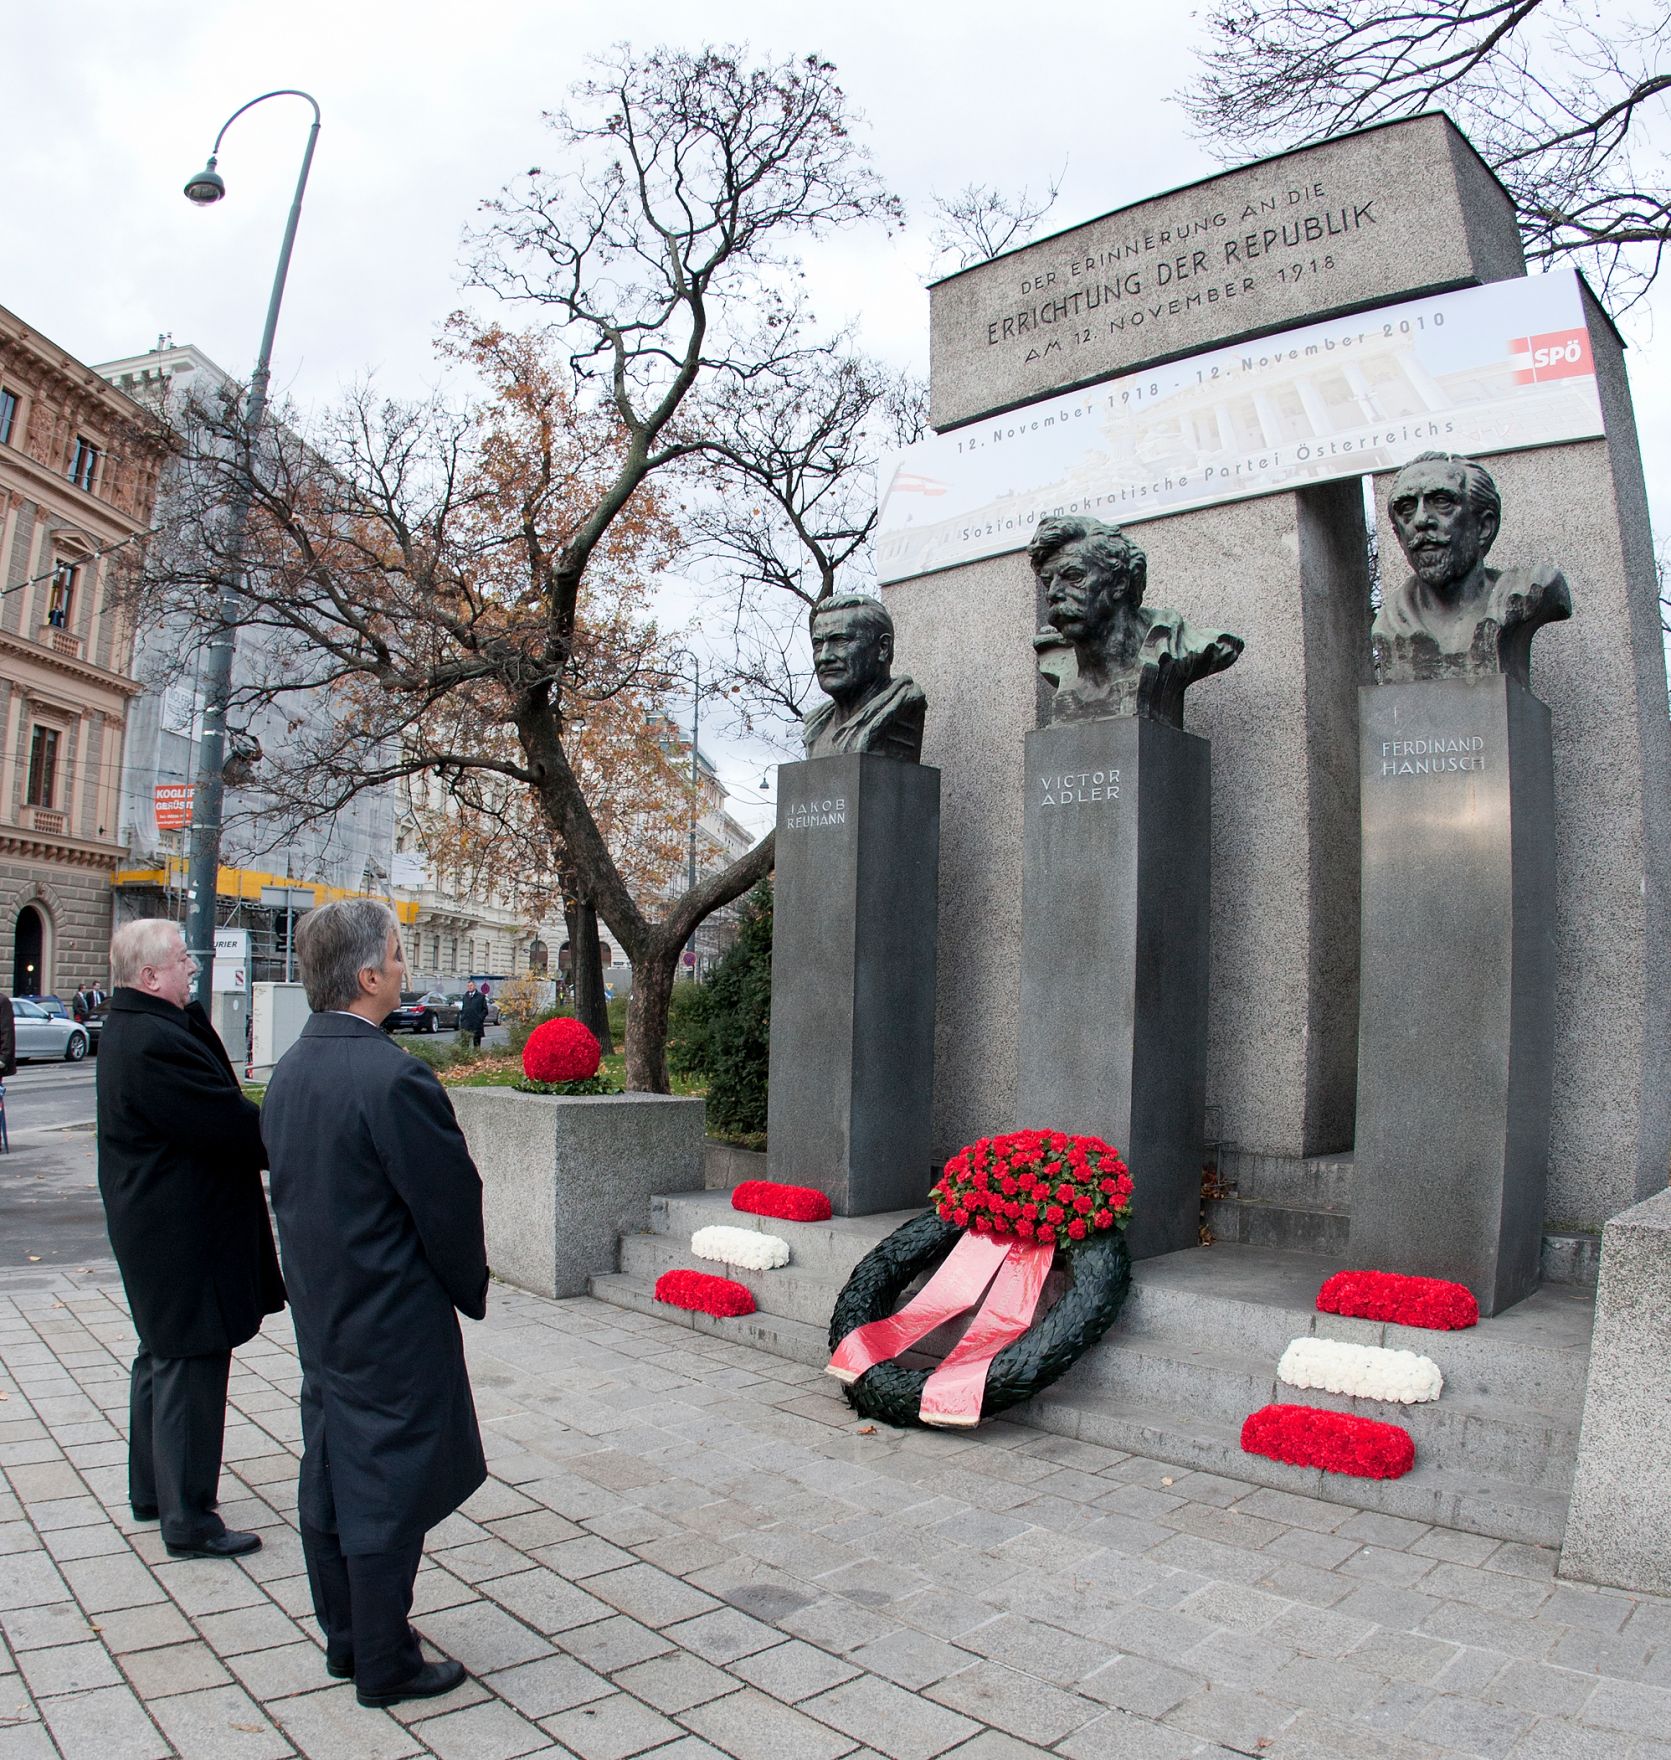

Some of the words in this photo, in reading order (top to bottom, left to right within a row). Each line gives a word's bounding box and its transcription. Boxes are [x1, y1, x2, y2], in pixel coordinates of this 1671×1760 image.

[1022, 272, 1056, 295] DER
[1071, 213, 1227, 276] ERINNERUNG
[1241, 197, 1275, 221] AN
[1288, 183, 1324, 204] DIE
[988, 272, 1141, 345] ERRICHTUNG
[1157, 250, 1208, 286] DER
[1224, 200, 1376, 265] REPUBLIK
[1024, 341, 1062, 363] AM
[1074, 329, 1098, 345] 12.
[1110, 278, 1255, 334] NOVEMBER
[1277, 256, 1335, 282] 1918
[1534, 339, 1581, 368] SPÖ
[957, 438, 985, 454] 12.
[993, 404, 1093, 443] November
[1108, 383, 1159, 408] 1918
[1196, 366, 1231, 384] 12.
[1241, 333, 1365, 371] November
[1383, 312, 1445, 338] 2010
[961, 476, 1189, 541] Sozialdemokratische
[1204, 452, 1280, 481] Partei
[1296, 421, 1454, 461] Österreichs
[1382, 736, 1484, 757] FERDINAND
[1041, 769, 1120, 790] VICTOR
[1383, 756, 1485, 776] HANUSCH
[1041, 786, 1120, 806] ADLER
[787, 812, 845, 829] REUMANN
